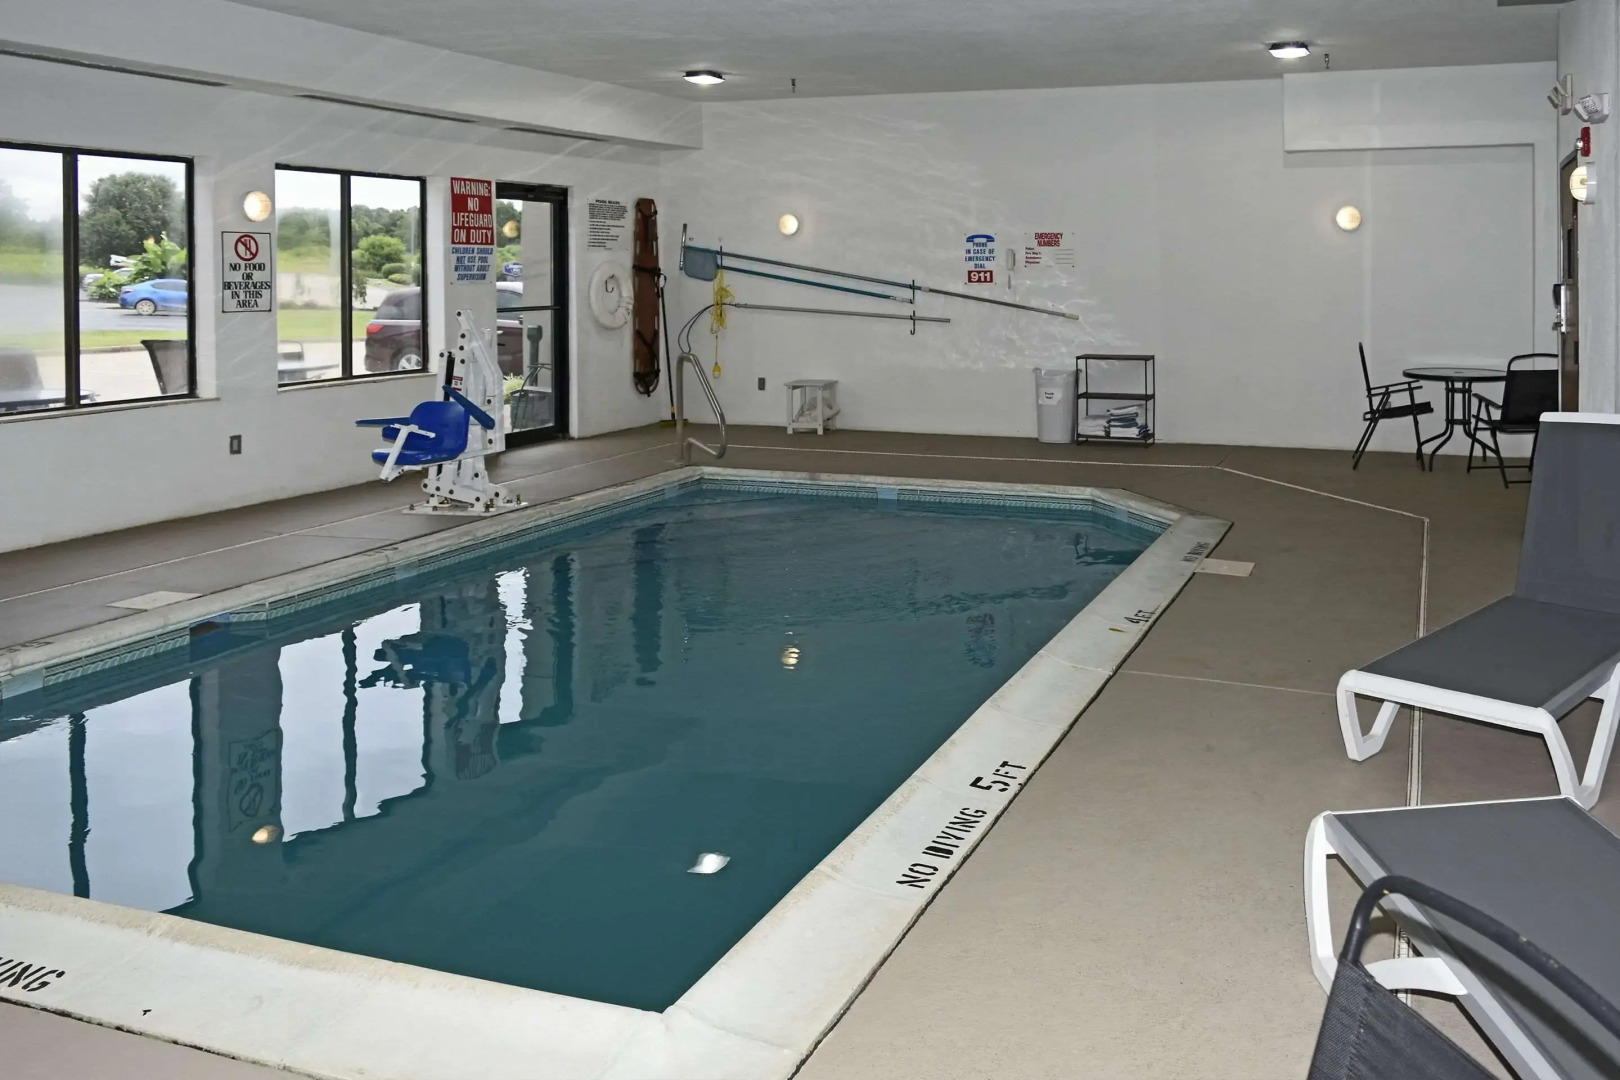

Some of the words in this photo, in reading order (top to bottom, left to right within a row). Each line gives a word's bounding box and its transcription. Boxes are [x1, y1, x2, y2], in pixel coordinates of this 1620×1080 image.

[452, 180, 491, 197] WARNING:
[467, 197, 480, 212] NO
[452, 212, 493, 228] LIFEGUARD
[453, 229, 467, 243] ON
[470, 229, 492, 244] DUTY
[1035, 232, 1063, 240] EMERGENCY
[1037, 239, 1061, 248] NUMBERS
[452, 246, 475, 255] CHILDREN
[476, 247, 494, 255] SHOULD
[456, 255, 467, 265] NOT
[467, 255, 477, 264] USE
[477, 255, 489, 264] POOL
[229, 262, 241, 272] NO
[244, 262, 266, 272] FOOD
[454, 264, 476, 272] WITHOUT
[476, 264, 491, 272] ADULT
[241, 272, 254, 281] OR
[456, 273, 487, 281] SUPERVISION
[970, 271, 991, 282] 911
[223, 280, 271, 291] BEVERAGES
[231, 290, 240, 300] IN
[243, 290, 263, 300] THIS
[236, 299, 259, 309] AREA
[896, 863, 939, 889] NO
[921, 807, 988, 859] DIVING
